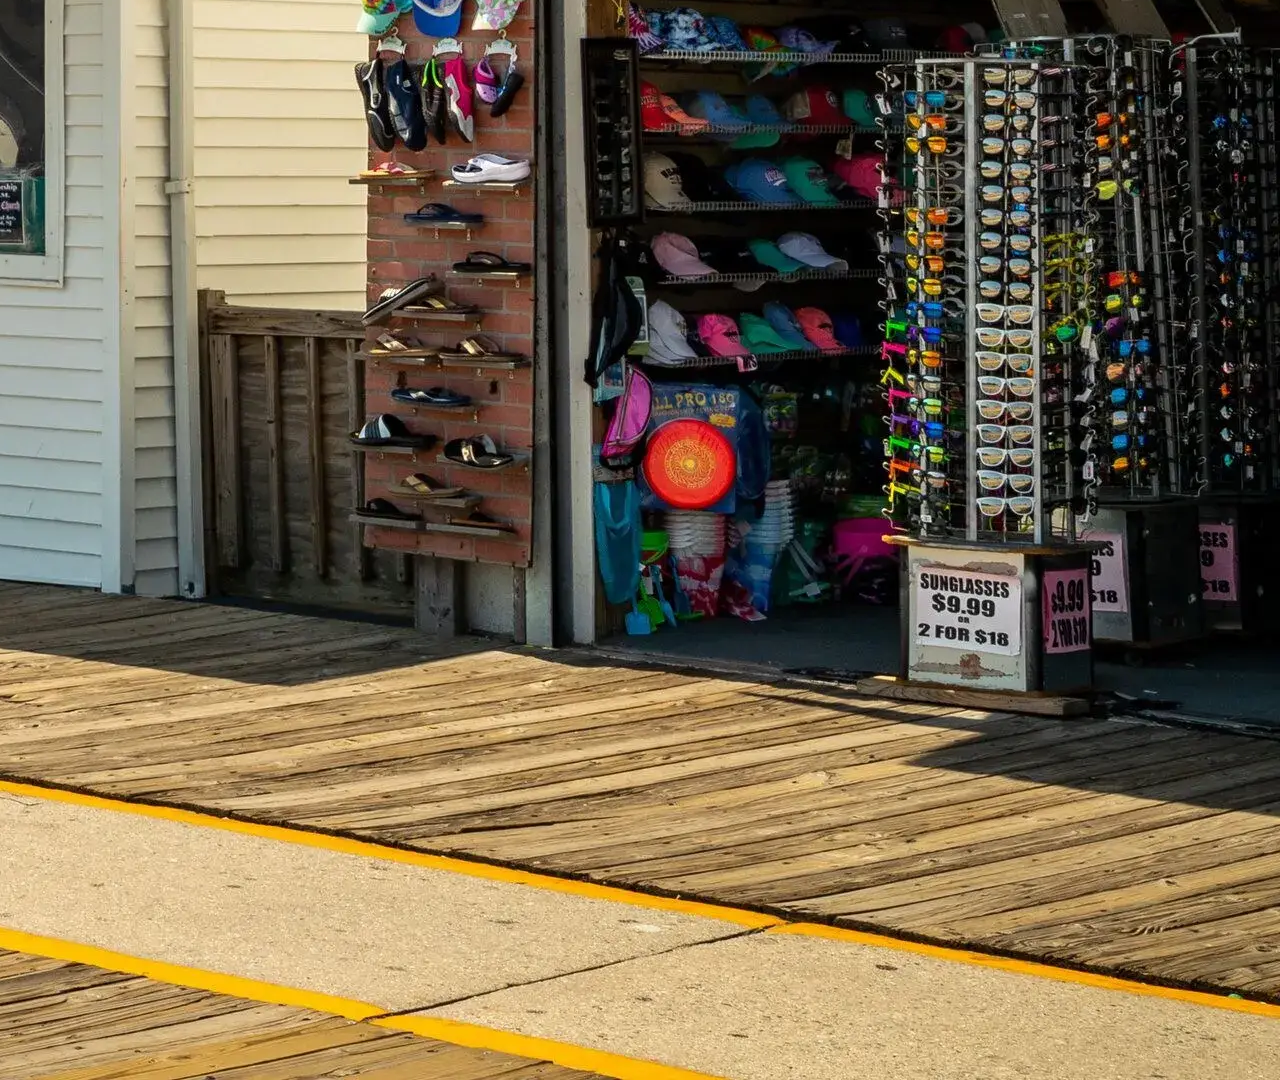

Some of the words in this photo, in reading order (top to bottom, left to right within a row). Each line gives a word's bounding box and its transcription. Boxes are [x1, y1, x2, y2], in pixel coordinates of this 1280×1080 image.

[675, 391, 706, 408] PRO
[920, 572, 1010, 598] SUNGLASSES
[1051, 579, 1084, 614] $9.99
[932, 592, 995, 617] $9.99
[957, 616, 970, 624] OR
[918, 623, 930, 637] 2
[935, 625, 970, 642] FOR
[974, 629, 1009, 647] $18
